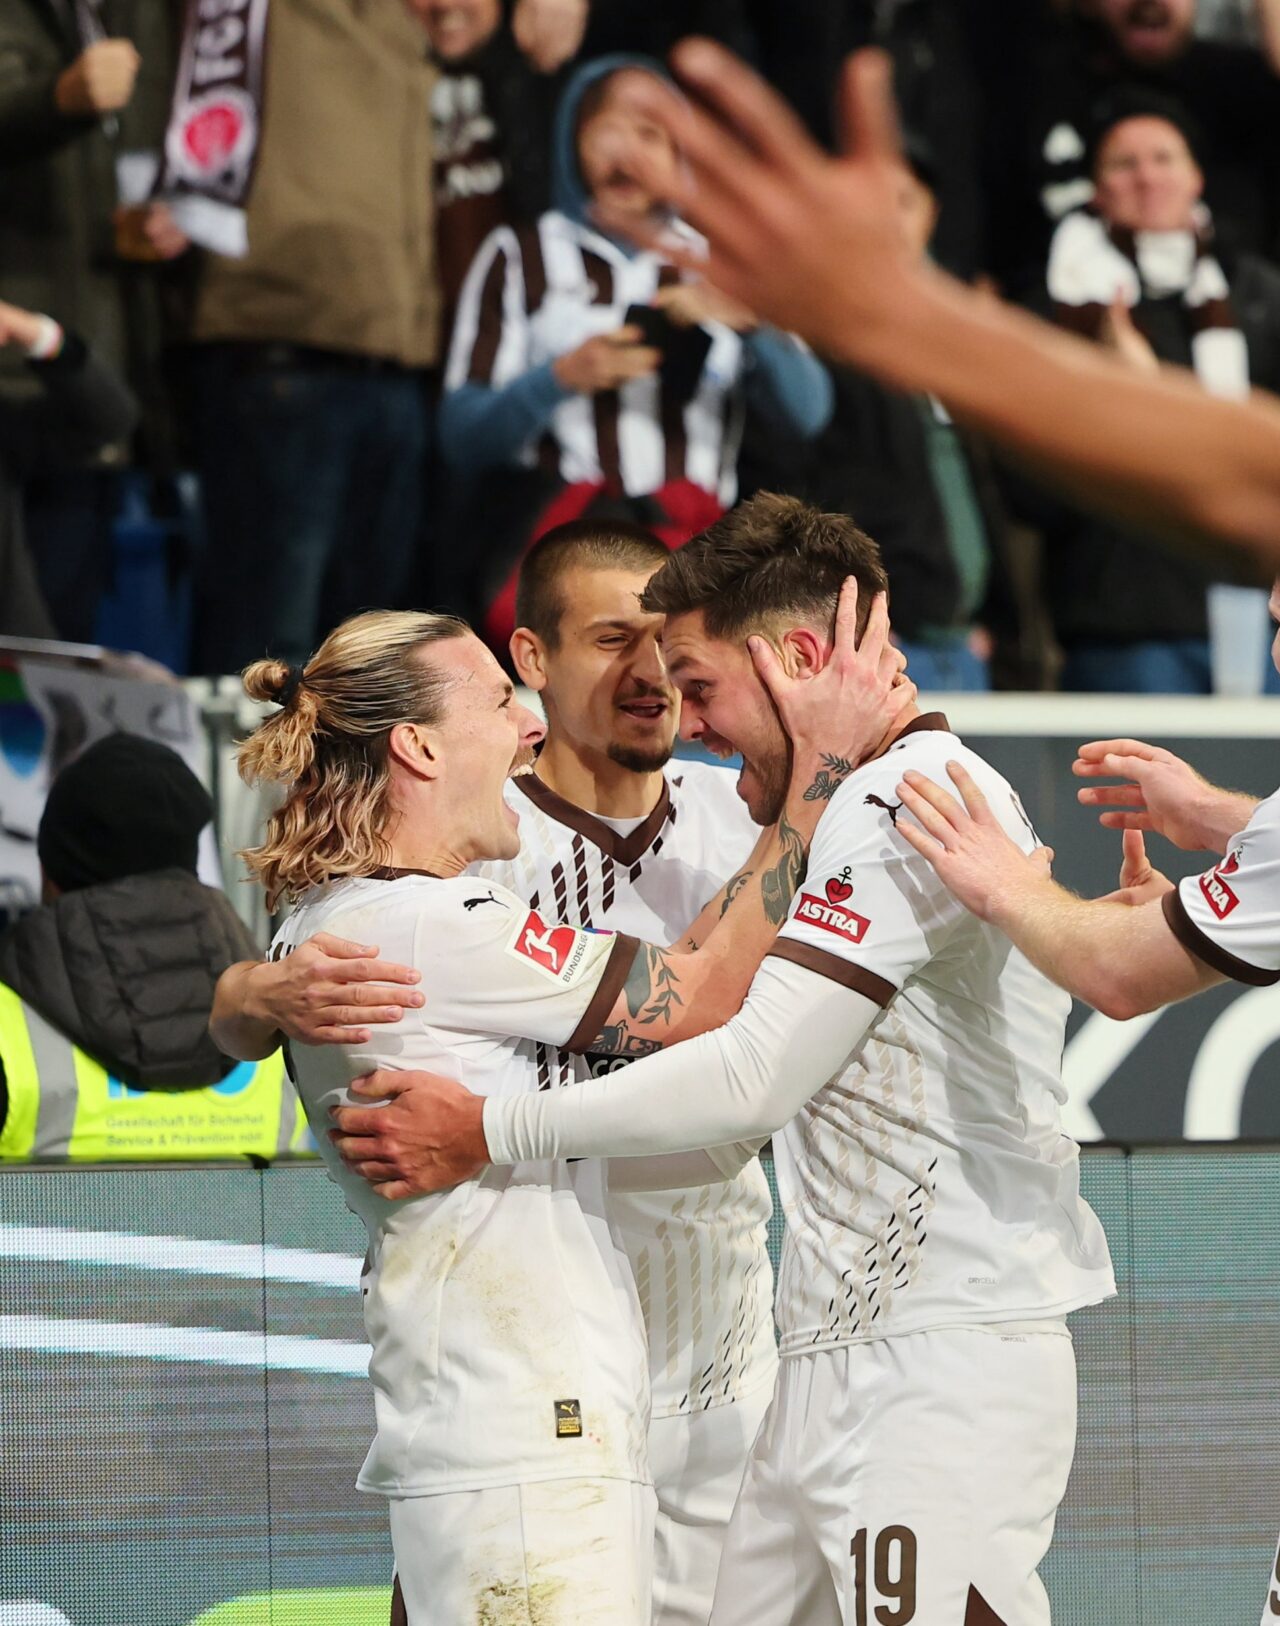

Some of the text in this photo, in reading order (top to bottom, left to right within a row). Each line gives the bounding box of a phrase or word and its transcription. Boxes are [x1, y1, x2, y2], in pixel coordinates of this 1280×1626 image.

[798, 900, 859, 937] ASTRA
[562, 934, 588, 983] BUNDESLIG
[106, 1133, 153, 1147] Service
[850, 1524, 918, 1626] 19
